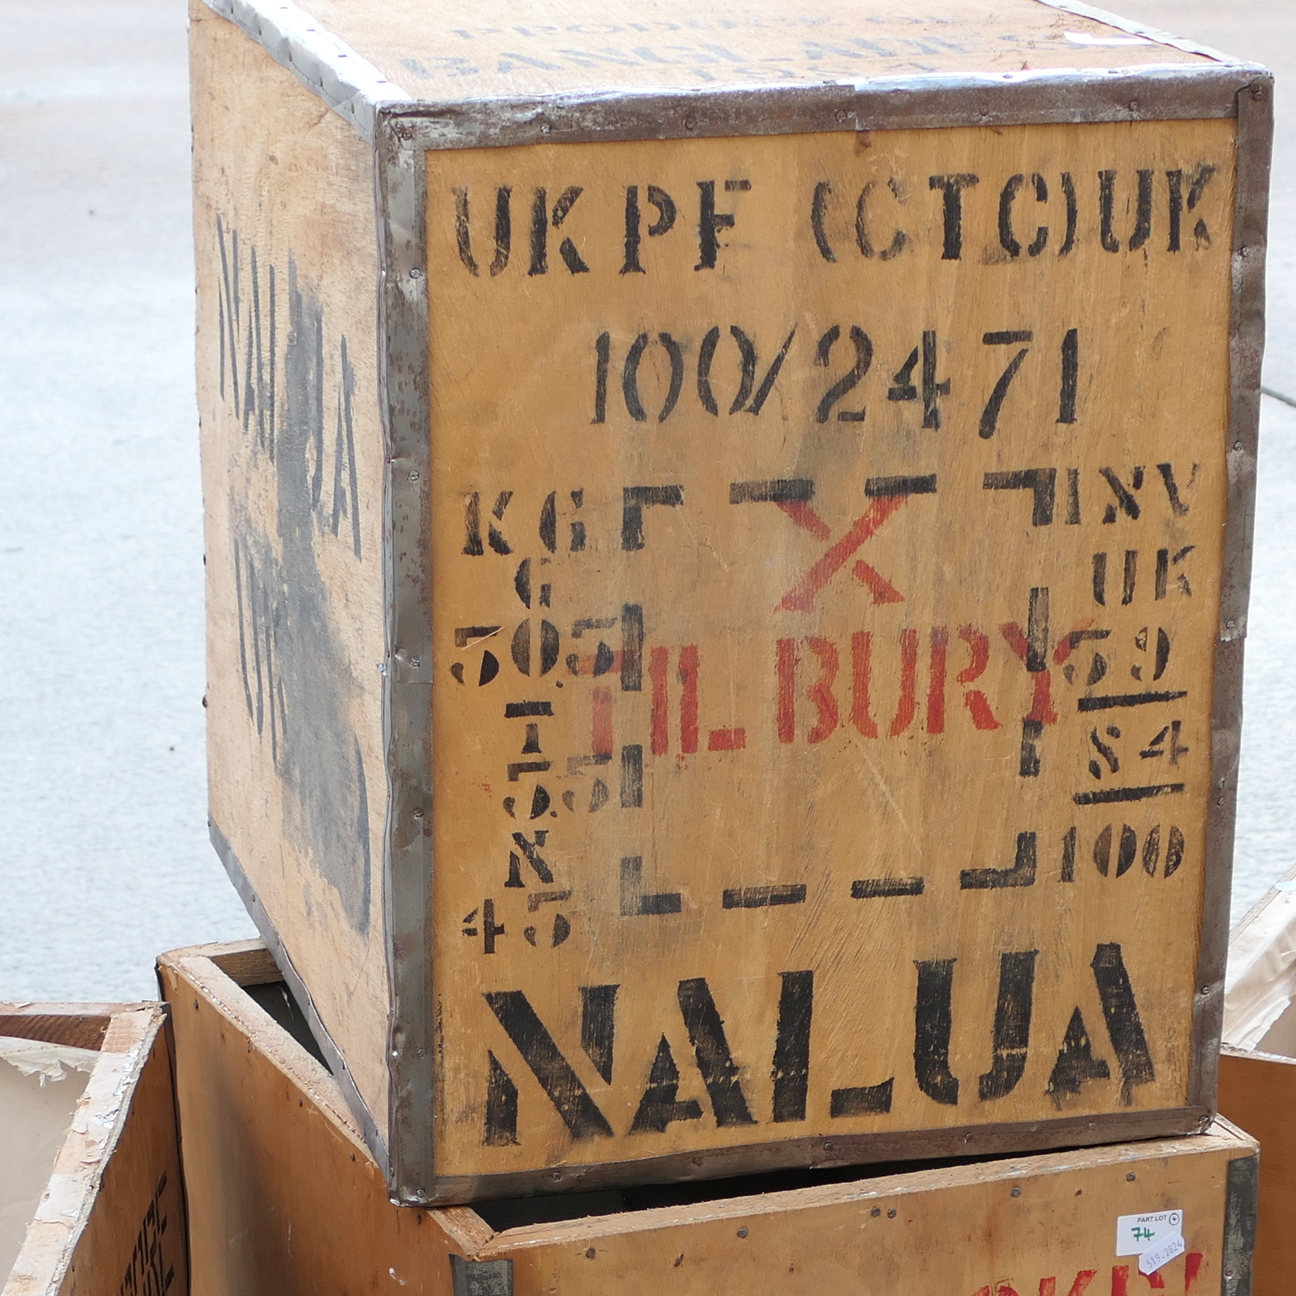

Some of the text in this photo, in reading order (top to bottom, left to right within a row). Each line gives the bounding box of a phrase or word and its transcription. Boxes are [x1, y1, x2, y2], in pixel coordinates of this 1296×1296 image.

[590, 322, 1079, 440] 100/2471
[1093, 544, 1196, 606] UK
[564, 618, 1095, 756] TILBURY
[1059, 822, 1185, 883] 100
[461, 889, 572, 955] 45
[482, 942, 1156, 1147] NALUA
[1131, 1226, 1156, 1242] 74
[1145, 1239, 1183, 1269] 519.2824
